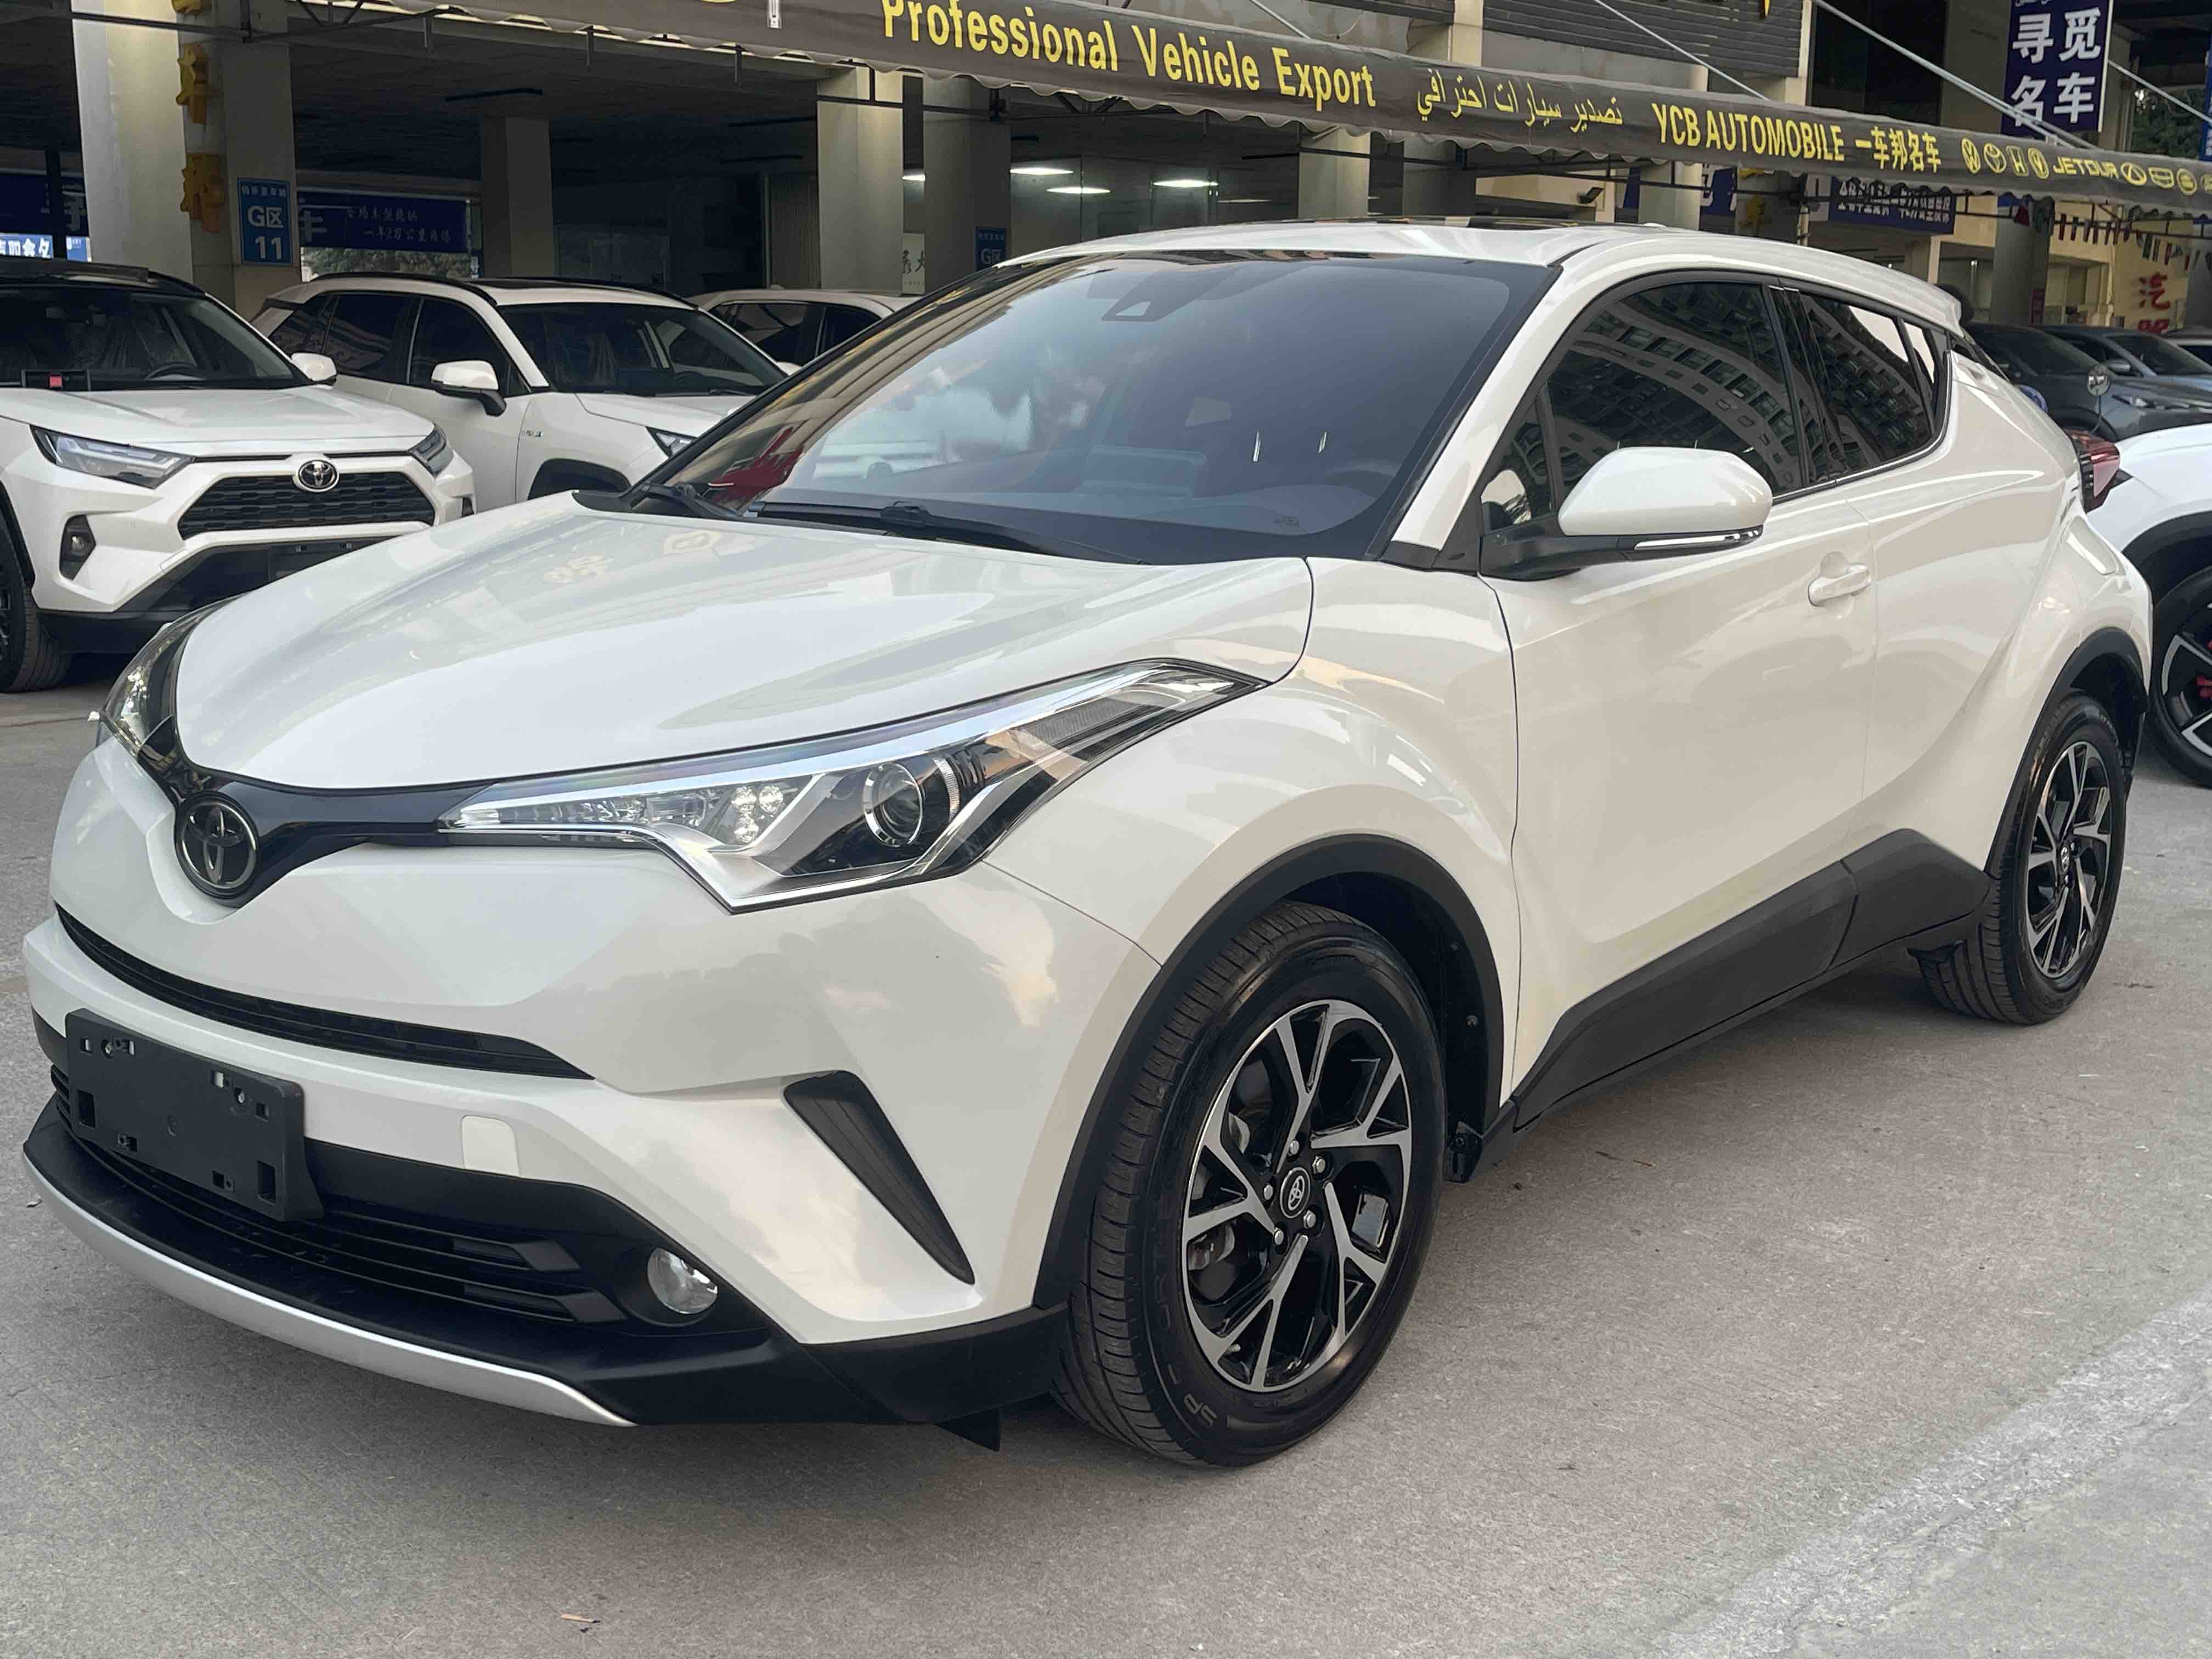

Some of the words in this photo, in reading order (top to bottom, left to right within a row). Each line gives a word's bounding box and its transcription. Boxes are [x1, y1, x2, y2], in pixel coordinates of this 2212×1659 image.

[882, 0, 1118, 72] Professional
[1131, 25, 1260, 91] Vehicle
[1272, 47, 1376, 111] Export
[2012, 7, 2101, 64] 寻觅
[2011, 72, 2095, 127] 名车
[1651, 103, 1700, 147] YCB
[1706, 110, 1845, 162] AUTOMOBILE
[1855, 126, 1942, 173] 一车邦名车
[2053, 156, 2119, 180] JETOUR
[247, 205, 284, 229] G区
[255, 236, 281, 259] 11
